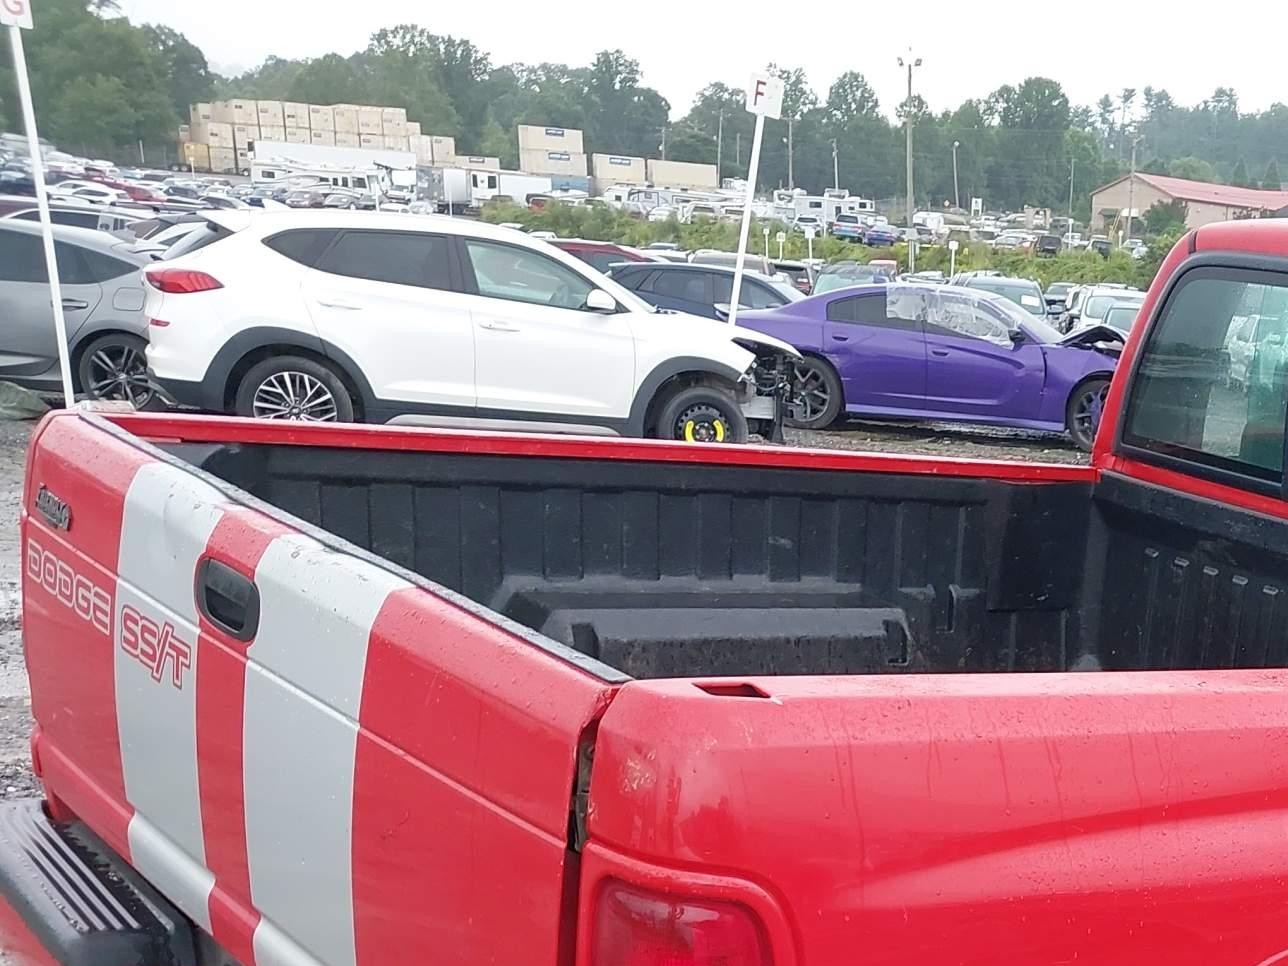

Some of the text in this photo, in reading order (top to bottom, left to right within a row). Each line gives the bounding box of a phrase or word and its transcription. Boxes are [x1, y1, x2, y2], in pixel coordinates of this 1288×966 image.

[753, 79, 767, 107] F
[27, 537, 192, 691] DODGE SS/T
